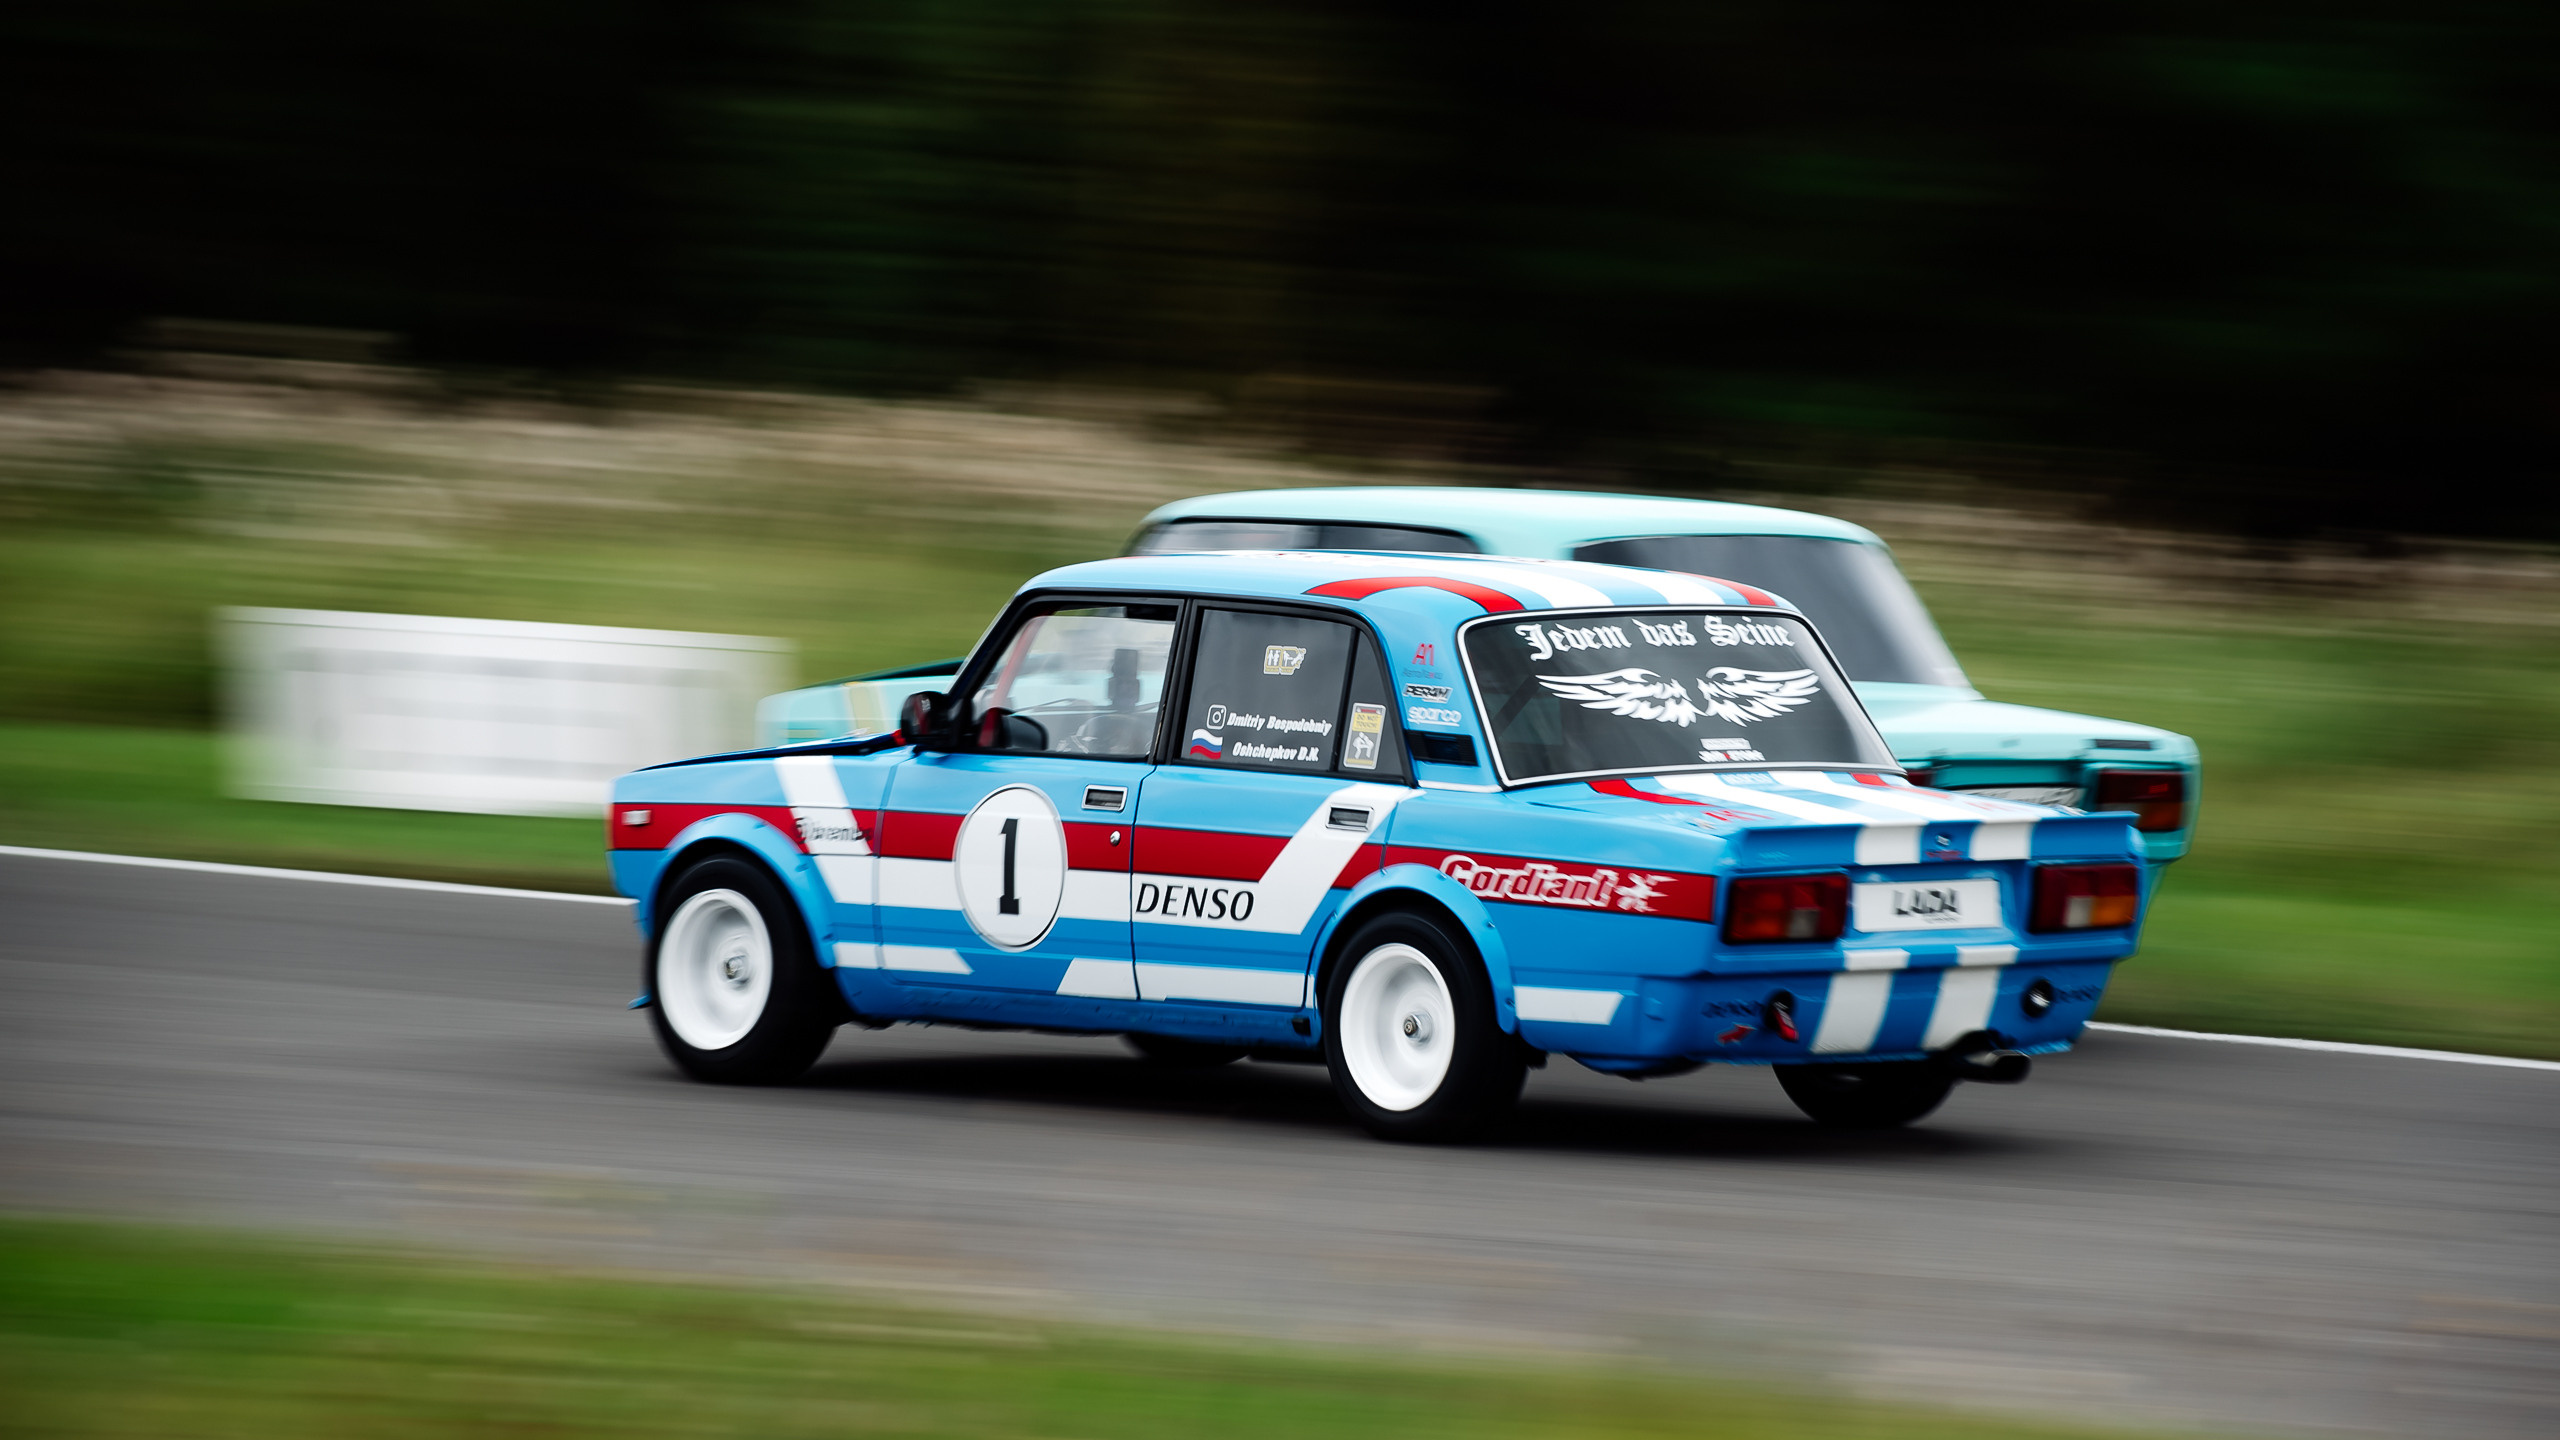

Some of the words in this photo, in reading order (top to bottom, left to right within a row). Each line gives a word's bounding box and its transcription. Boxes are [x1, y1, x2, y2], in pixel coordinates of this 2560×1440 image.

[1515, 622, 1632, 661] Jedem
[1632, 618, 1697, 647] das
[1704, 615, 1795, 648] Seine
[1227, 712, 1265, 731] Dmitriy
[1408, 706, 1462, 724] sparco
[999, 818, 1021, 916] 1
[1135, 882, 1255, 922] DENSO
